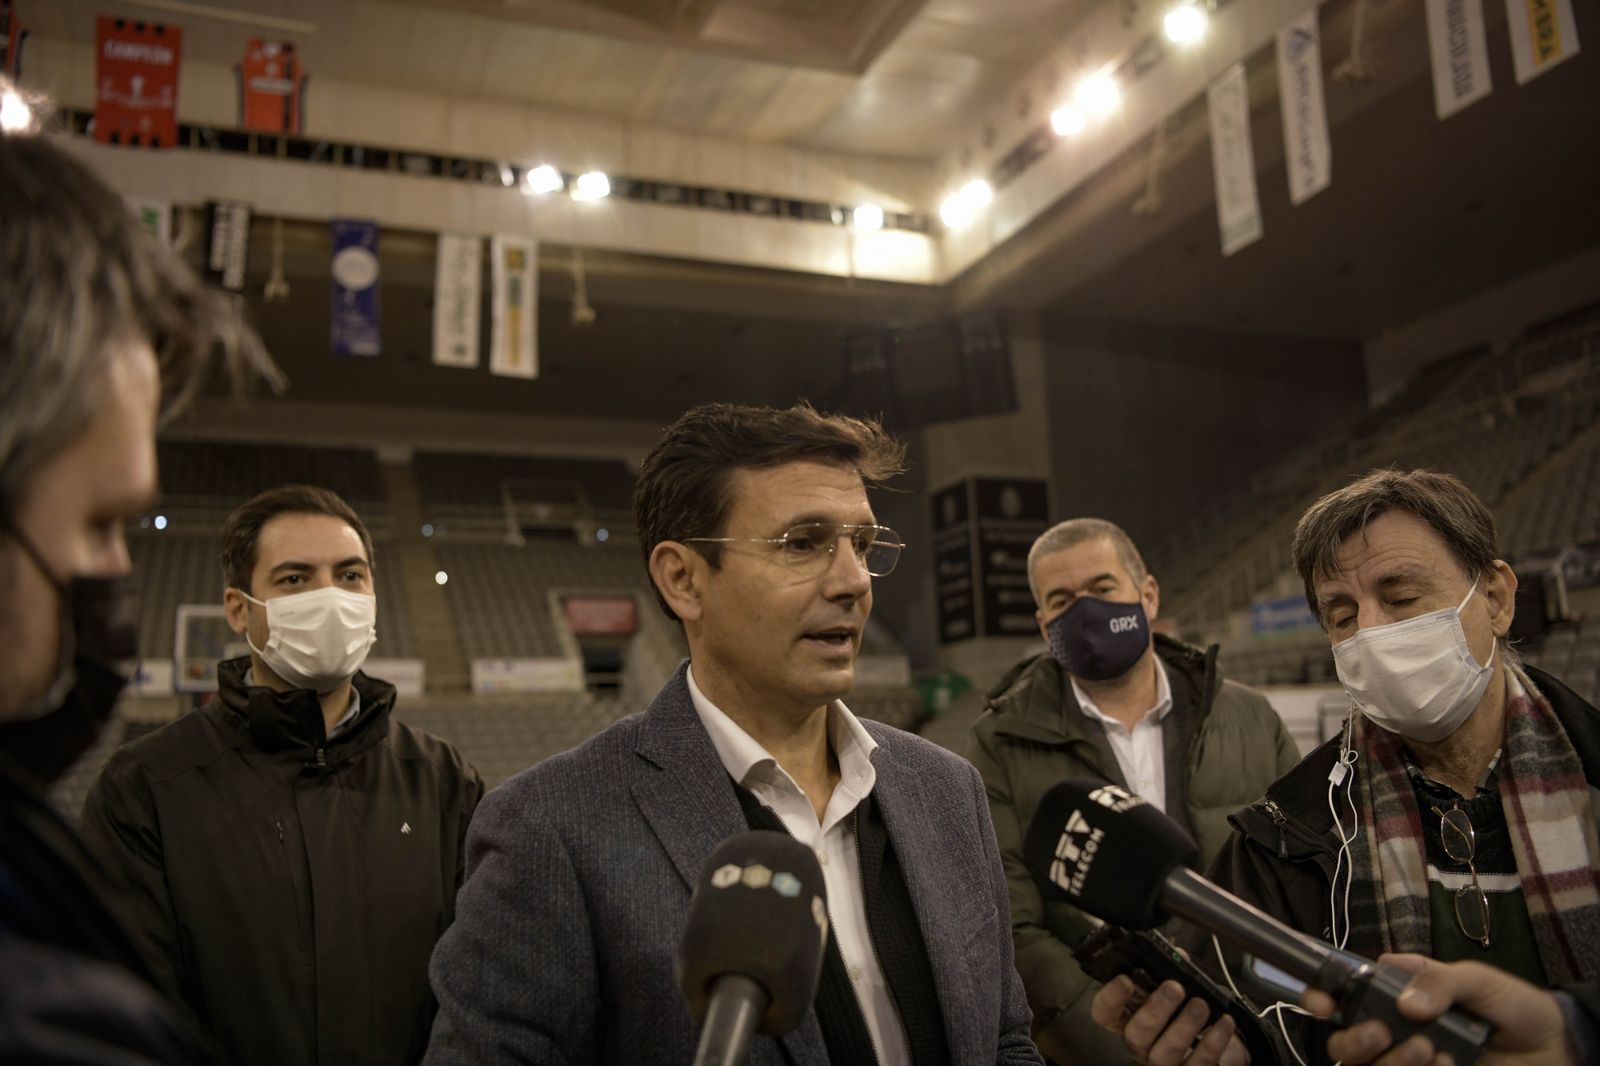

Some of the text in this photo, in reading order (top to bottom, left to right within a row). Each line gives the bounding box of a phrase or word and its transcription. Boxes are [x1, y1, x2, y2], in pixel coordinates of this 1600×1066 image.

[1110, 615, 1138, 633] GRX
[1050, 809, 1091, 891] PTV
[1070, 827, 1104, 896] TELECOM
